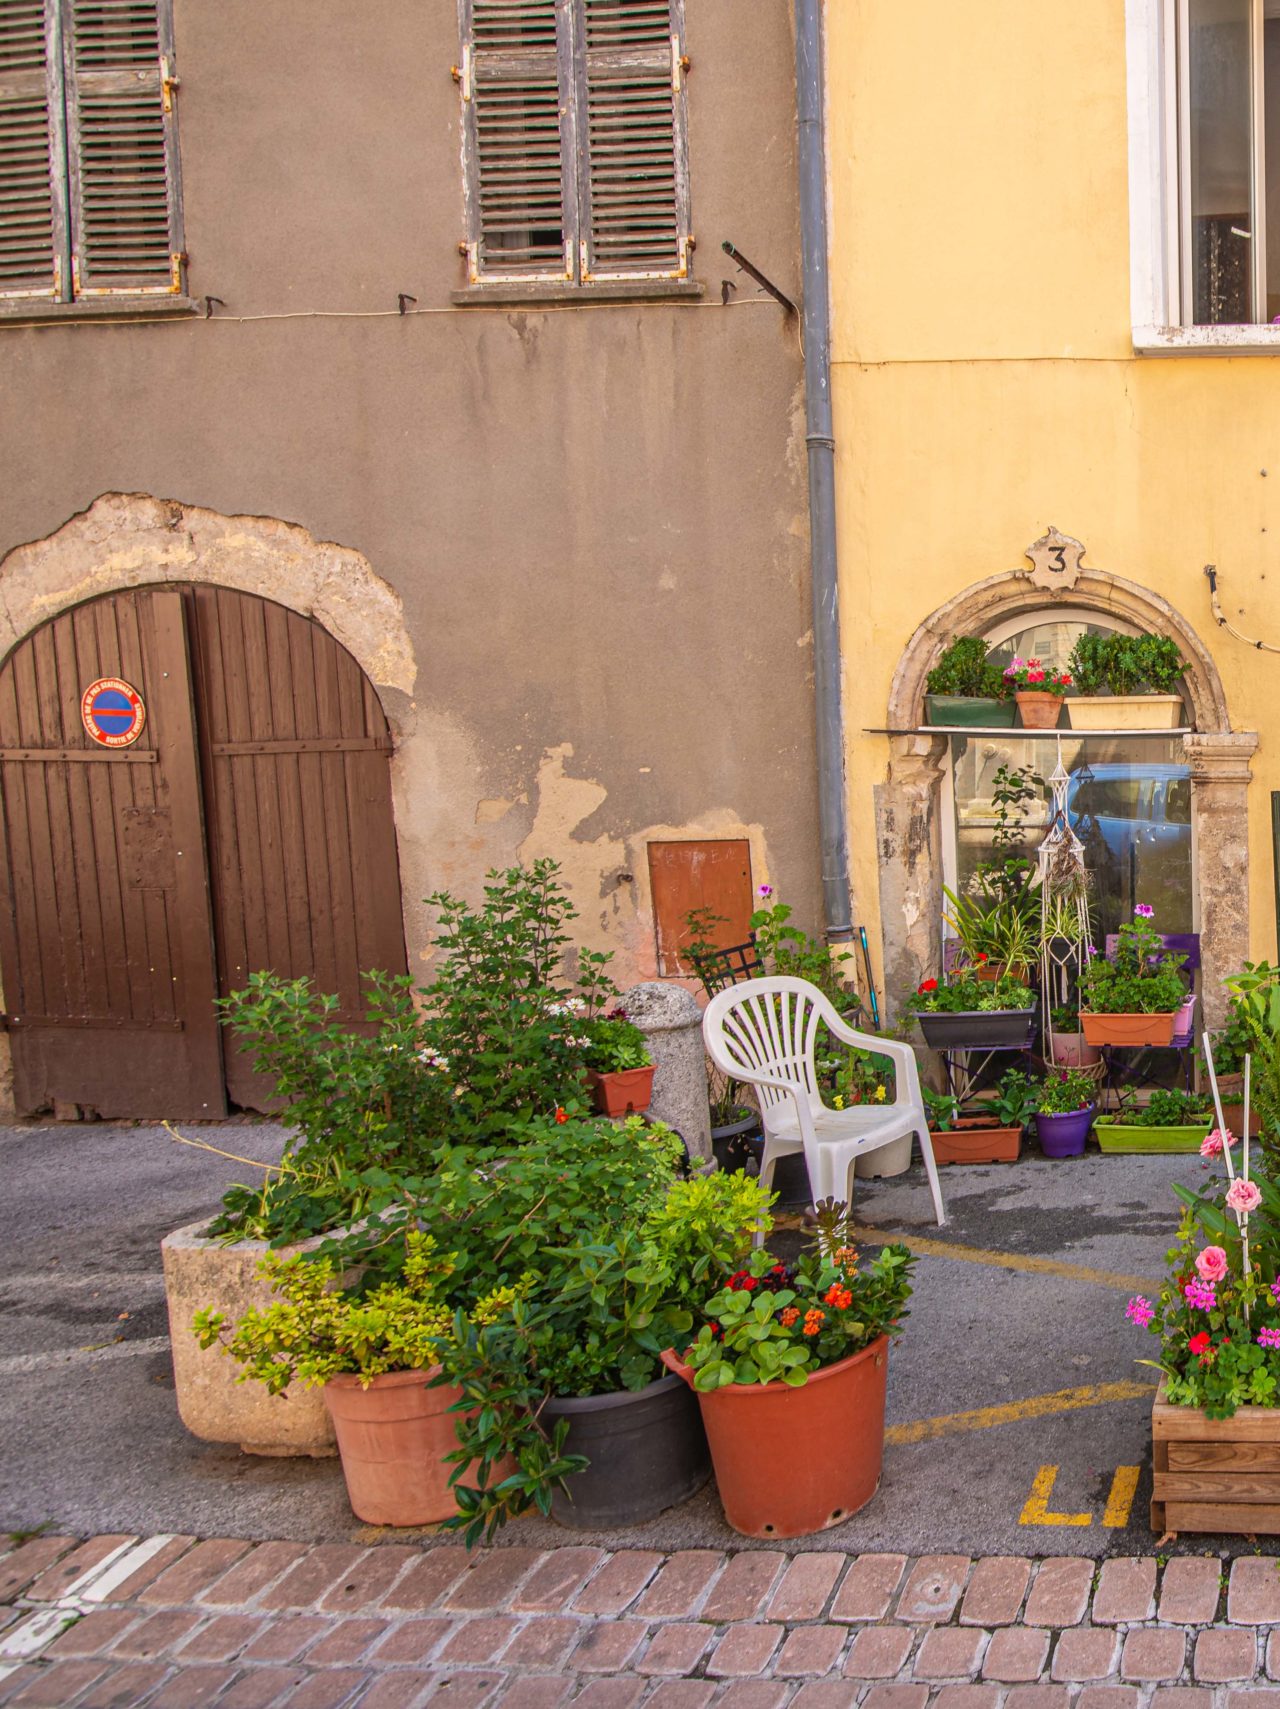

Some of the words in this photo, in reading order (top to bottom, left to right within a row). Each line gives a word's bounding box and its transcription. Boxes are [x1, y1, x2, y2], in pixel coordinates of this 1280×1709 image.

[1048, 546, 1066, 573] 3
[89, 685, 101, 697] PAS
[100, 681, 133, 698] STATIONNER
[105, 736, 127, 744] SORTIE
[132, 703, 142, 733] VOITURES
